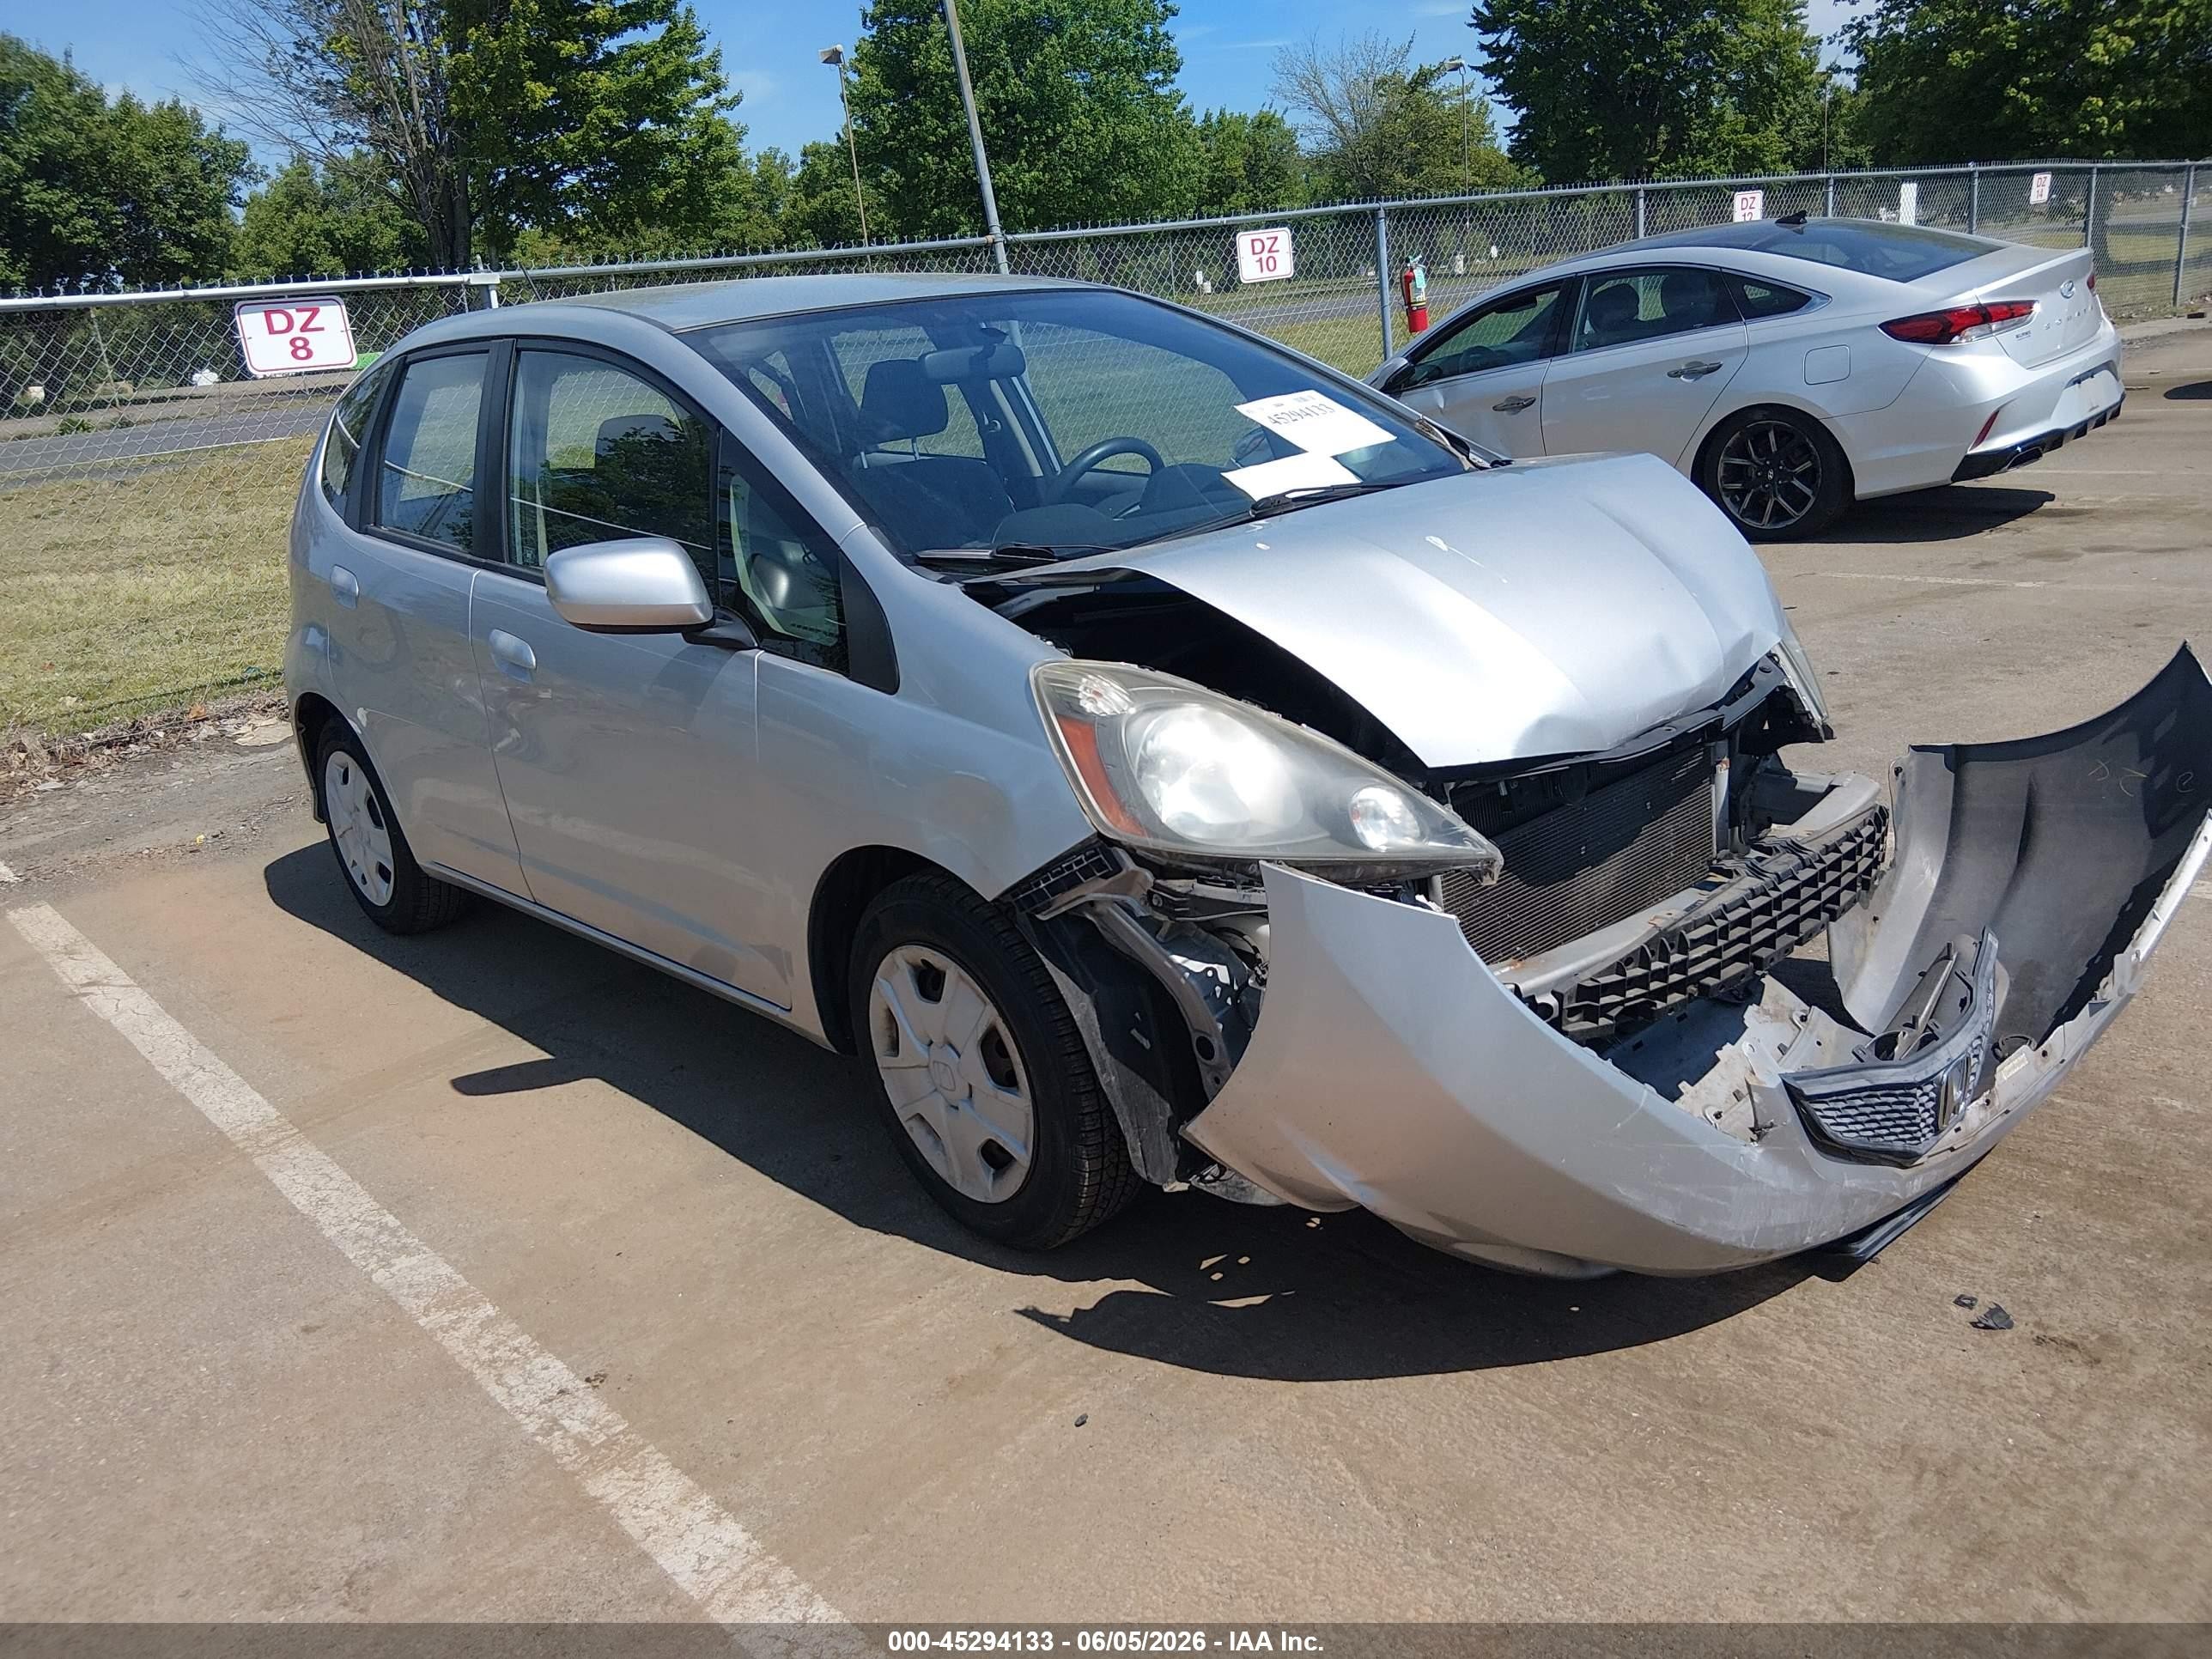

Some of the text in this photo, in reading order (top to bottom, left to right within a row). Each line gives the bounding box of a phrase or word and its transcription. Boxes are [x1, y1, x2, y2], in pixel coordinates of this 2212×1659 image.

[2036, 176, 2047, 188] DZ
[1741, 197, 1756, 210] DZ
[1250, 236, 1279, 256] DZ
[1255, 256, 1277, 274] 10
[264, 307, 325, 335] DZ
[289, 337, 313, 361] 8
[1267, 404, 1335, 425] 45294133
